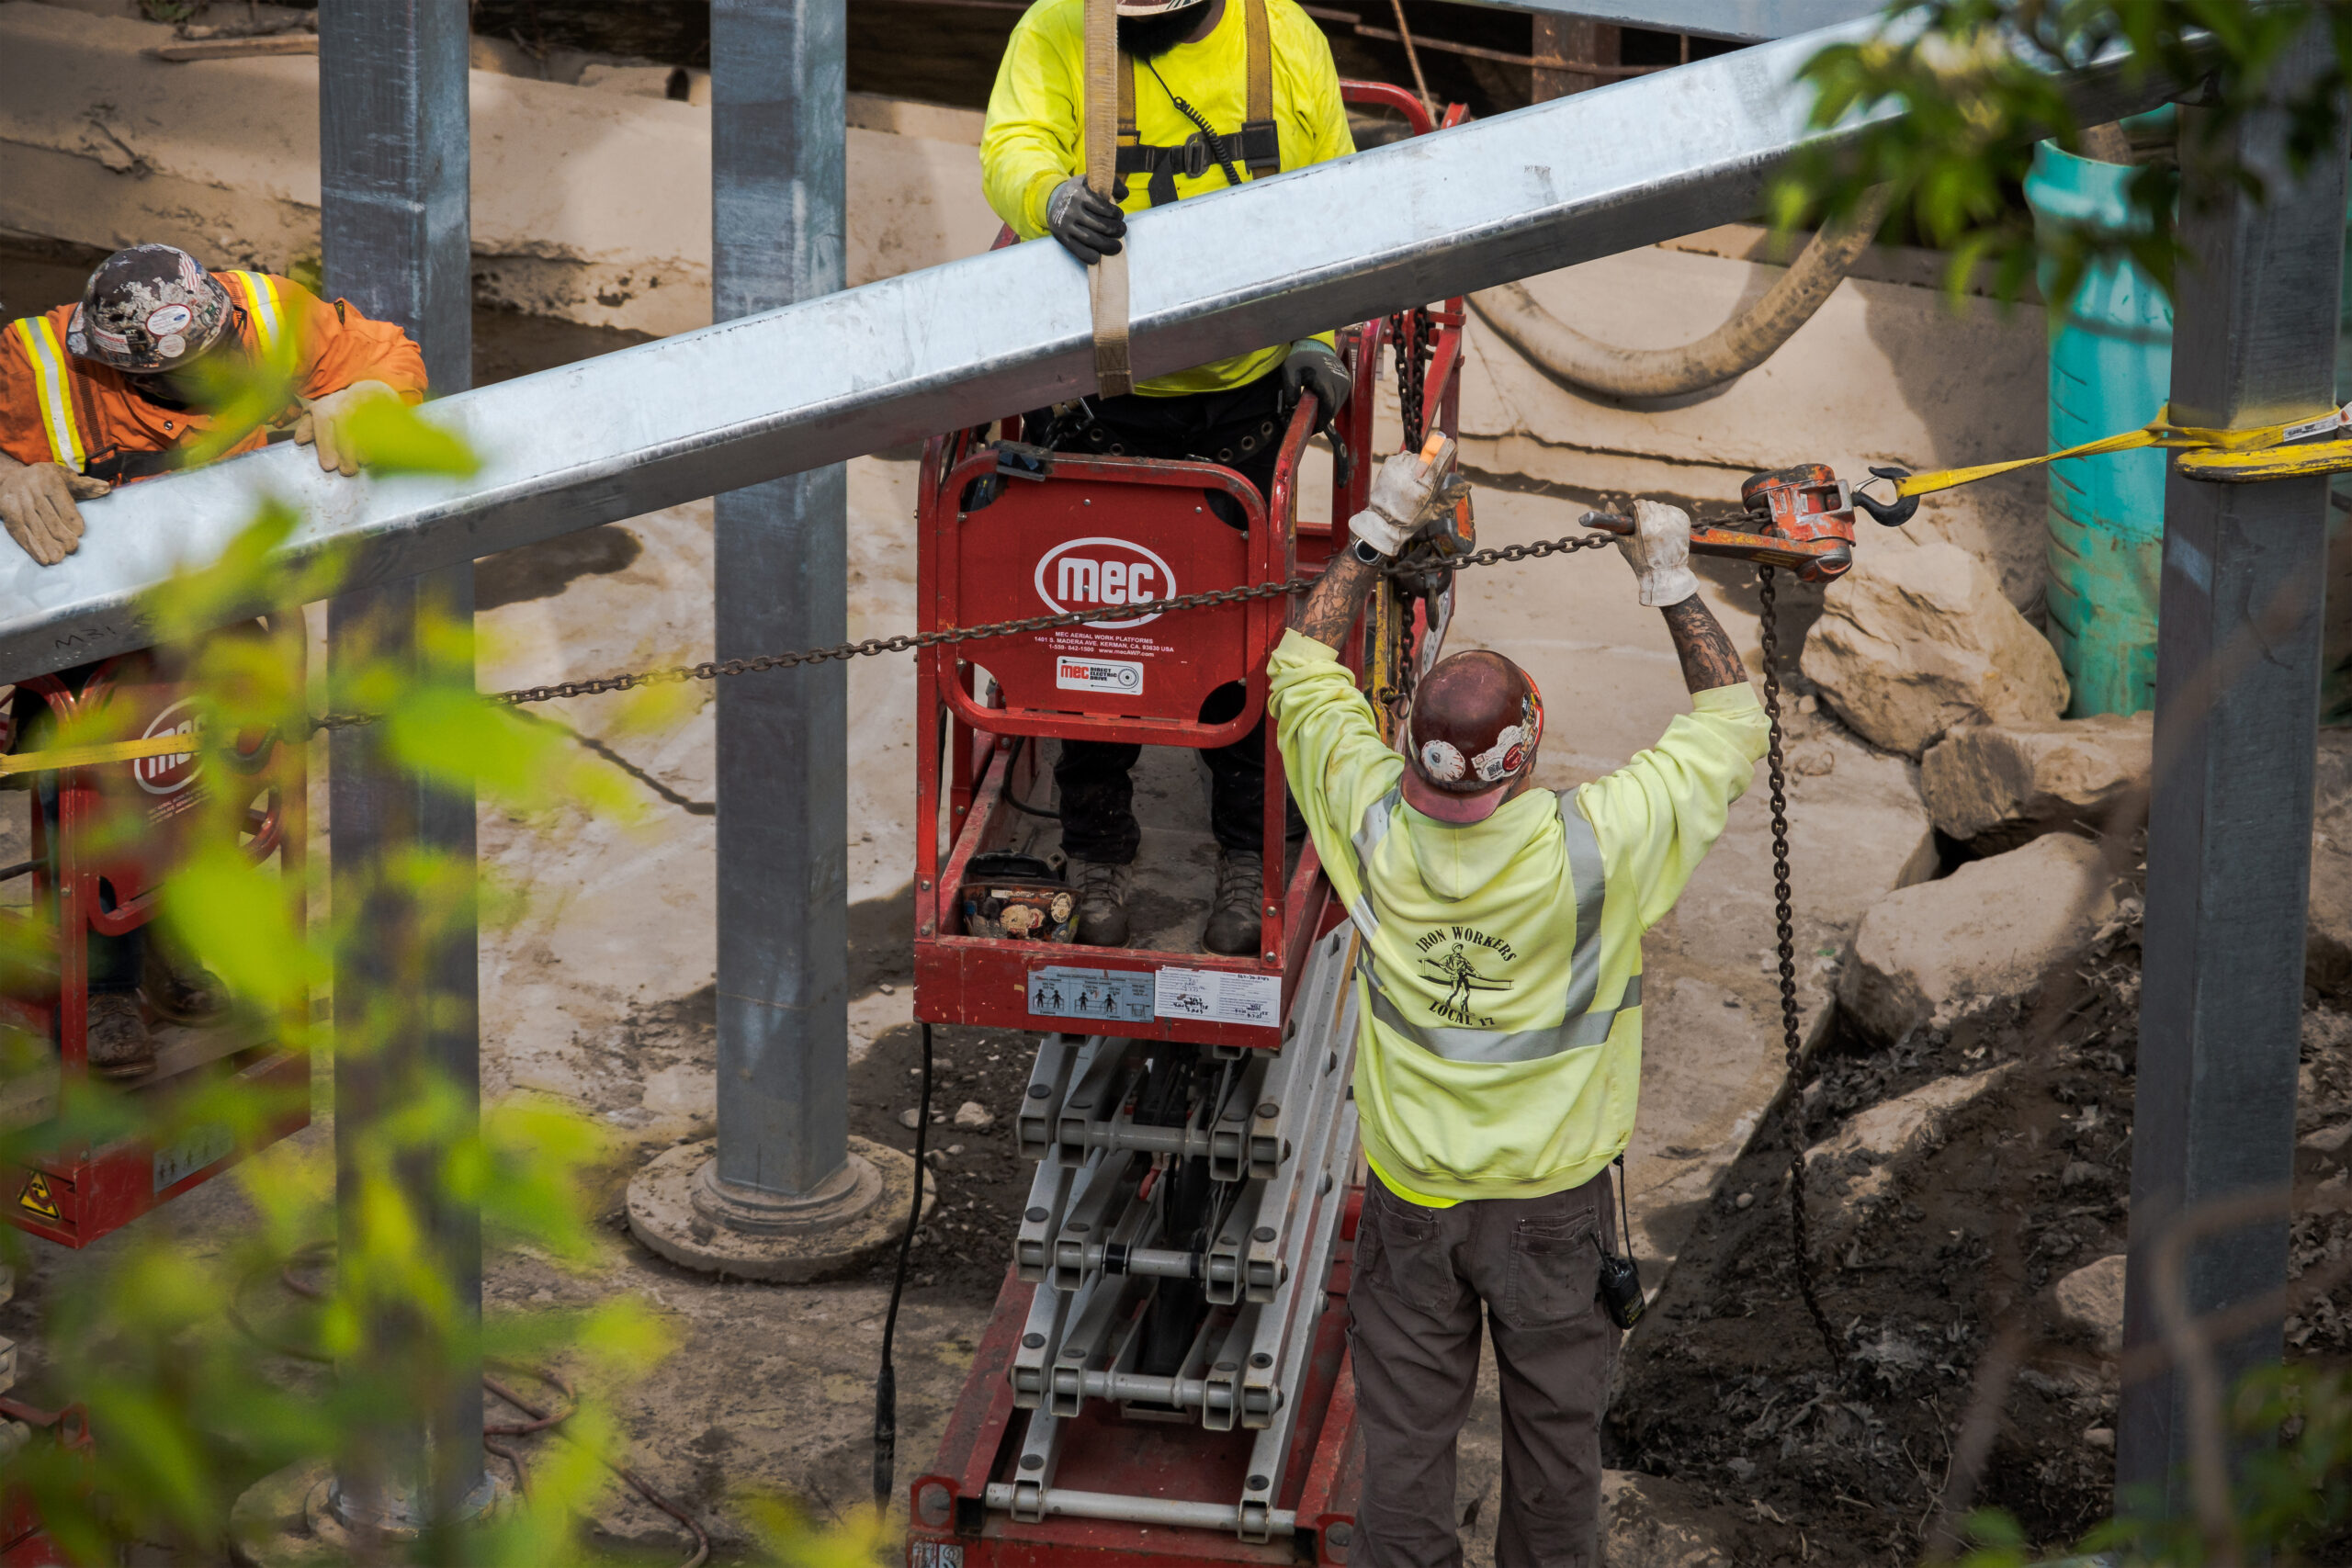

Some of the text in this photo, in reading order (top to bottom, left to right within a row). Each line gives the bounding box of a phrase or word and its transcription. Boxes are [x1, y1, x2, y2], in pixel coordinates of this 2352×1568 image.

[1099, 648, 1154, 657] www.mecAWP.com
[1061, 665, 1089, 679] mec
[1415, 926, 1517, 961] IRON WORKERS
[1428, 1000, 1472, 1026] LOCAL
